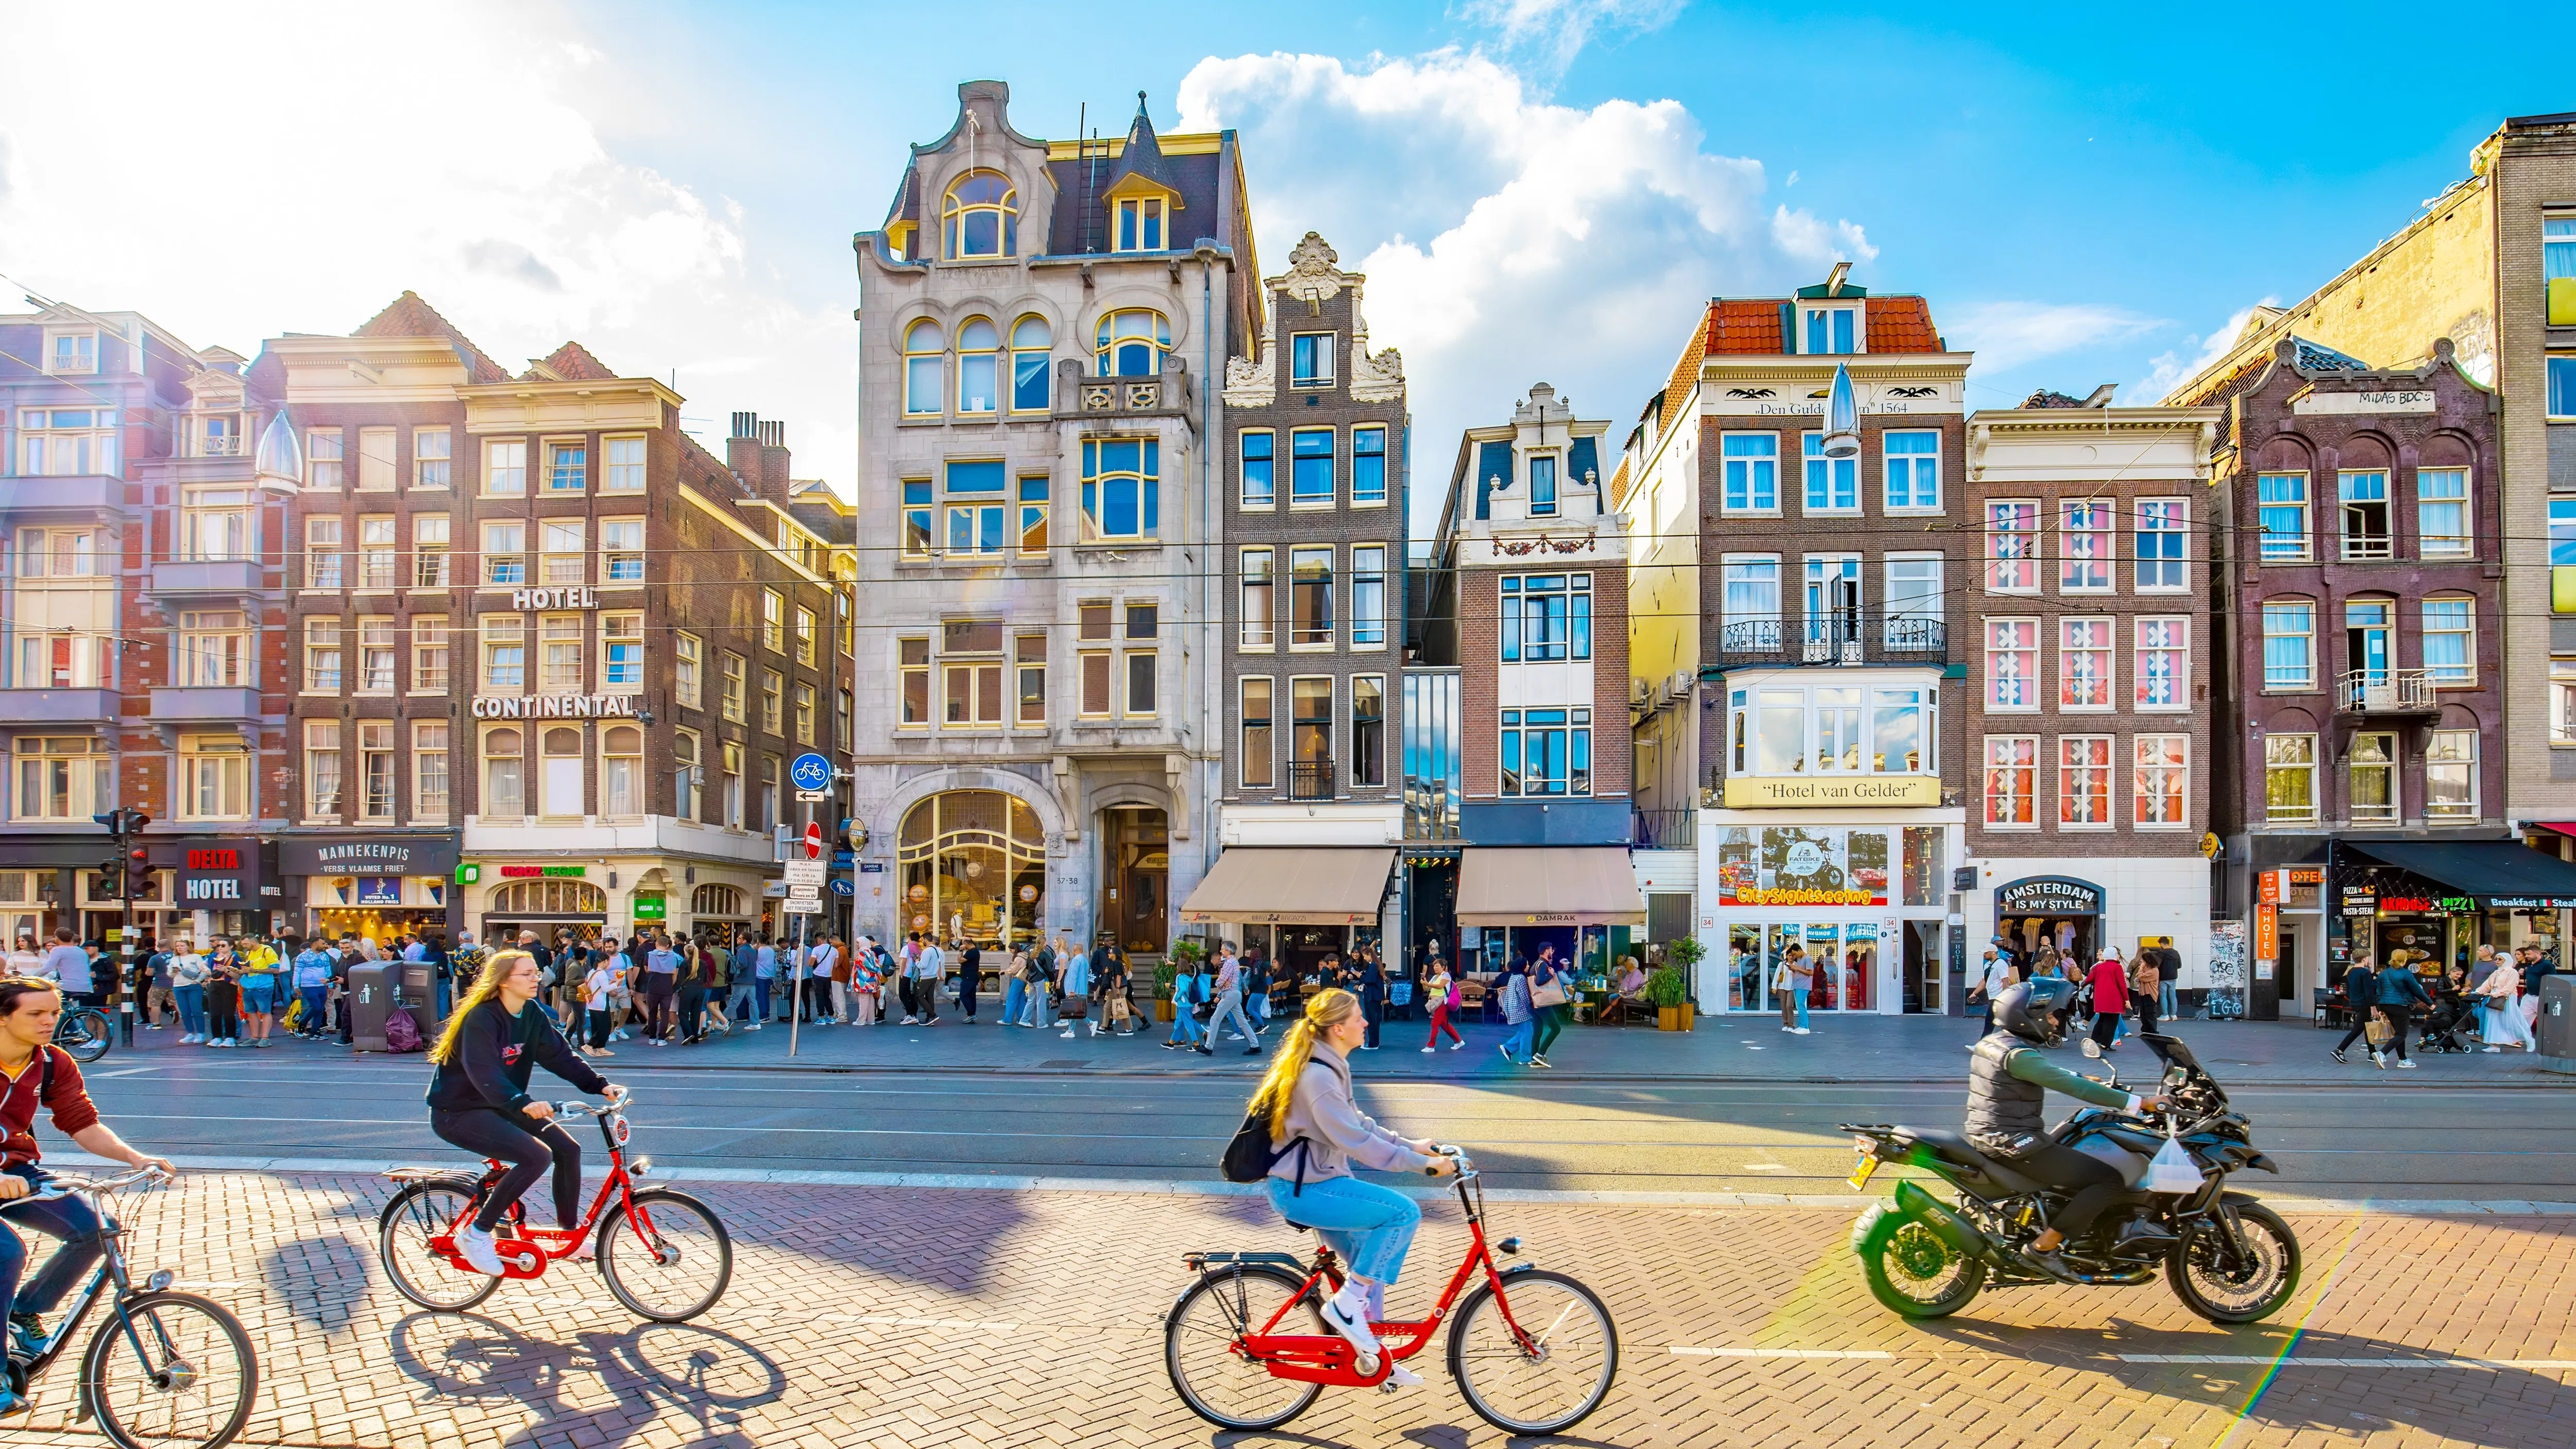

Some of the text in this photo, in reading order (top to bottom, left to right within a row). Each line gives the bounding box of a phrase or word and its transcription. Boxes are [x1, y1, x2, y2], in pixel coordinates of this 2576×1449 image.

[2359, 391, 2424, 404] MIDAS BDC
[1790, 403, 1826, 415] Gulde
[1880, 402, 1908, 413] 1564
[513, 588, 594, 609] HOTEL
[472, 695, 634, 718] CONTINENTAL
[1821, 786, 1849, 797] van
[318, 844, 410, 861] MANNEKENPIS
[188, 849, 239, 870] DELTA
[2289, 871, 2327, 883] OTEL
[186, 879, 240, 899] HOTEL
[261, 886, 281, 896] HOTEL
[2005, 883, 2095, 902] AMSTERDAM
[2343, 886, 2358, 895] PIZZA
[1737, 886, 1872, 905] CitySightseeing
[2016, 900, 2082, 909] IS MY STYLE
[2490, 898, 2537, 907] Breakfast
[2343, 907, 2374, 915] PASTA-STEAK
[1737, 925, 1756, 937] DISCOUNT
[2013, 1136, 2035, 1148] HUGO
